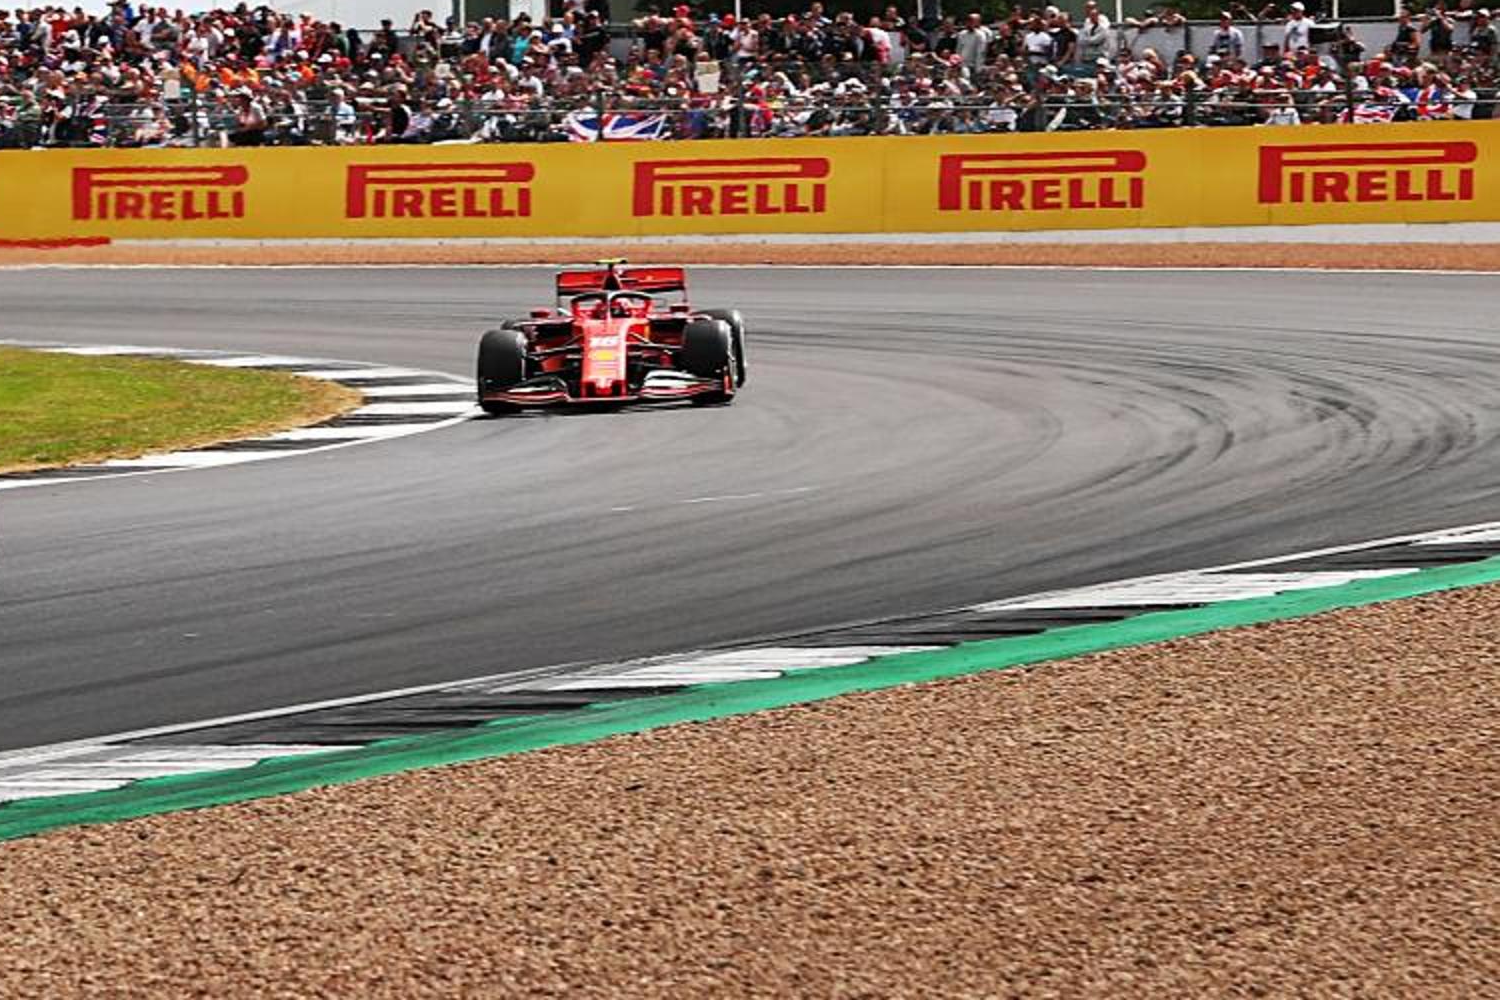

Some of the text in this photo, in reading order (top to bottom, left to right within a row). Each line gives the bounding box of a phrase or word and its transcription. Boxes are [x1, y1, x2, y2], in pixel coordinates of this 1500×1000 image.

[71, 165, 248, 220] PIRELLI
[345, 162, 535, 218] PIRELLI
[632, 157, 830, 217] PIRELLI
[938, 150, 1147, 211] PIRELLI
[1258, 141, 1477, 204] PIRELLI
